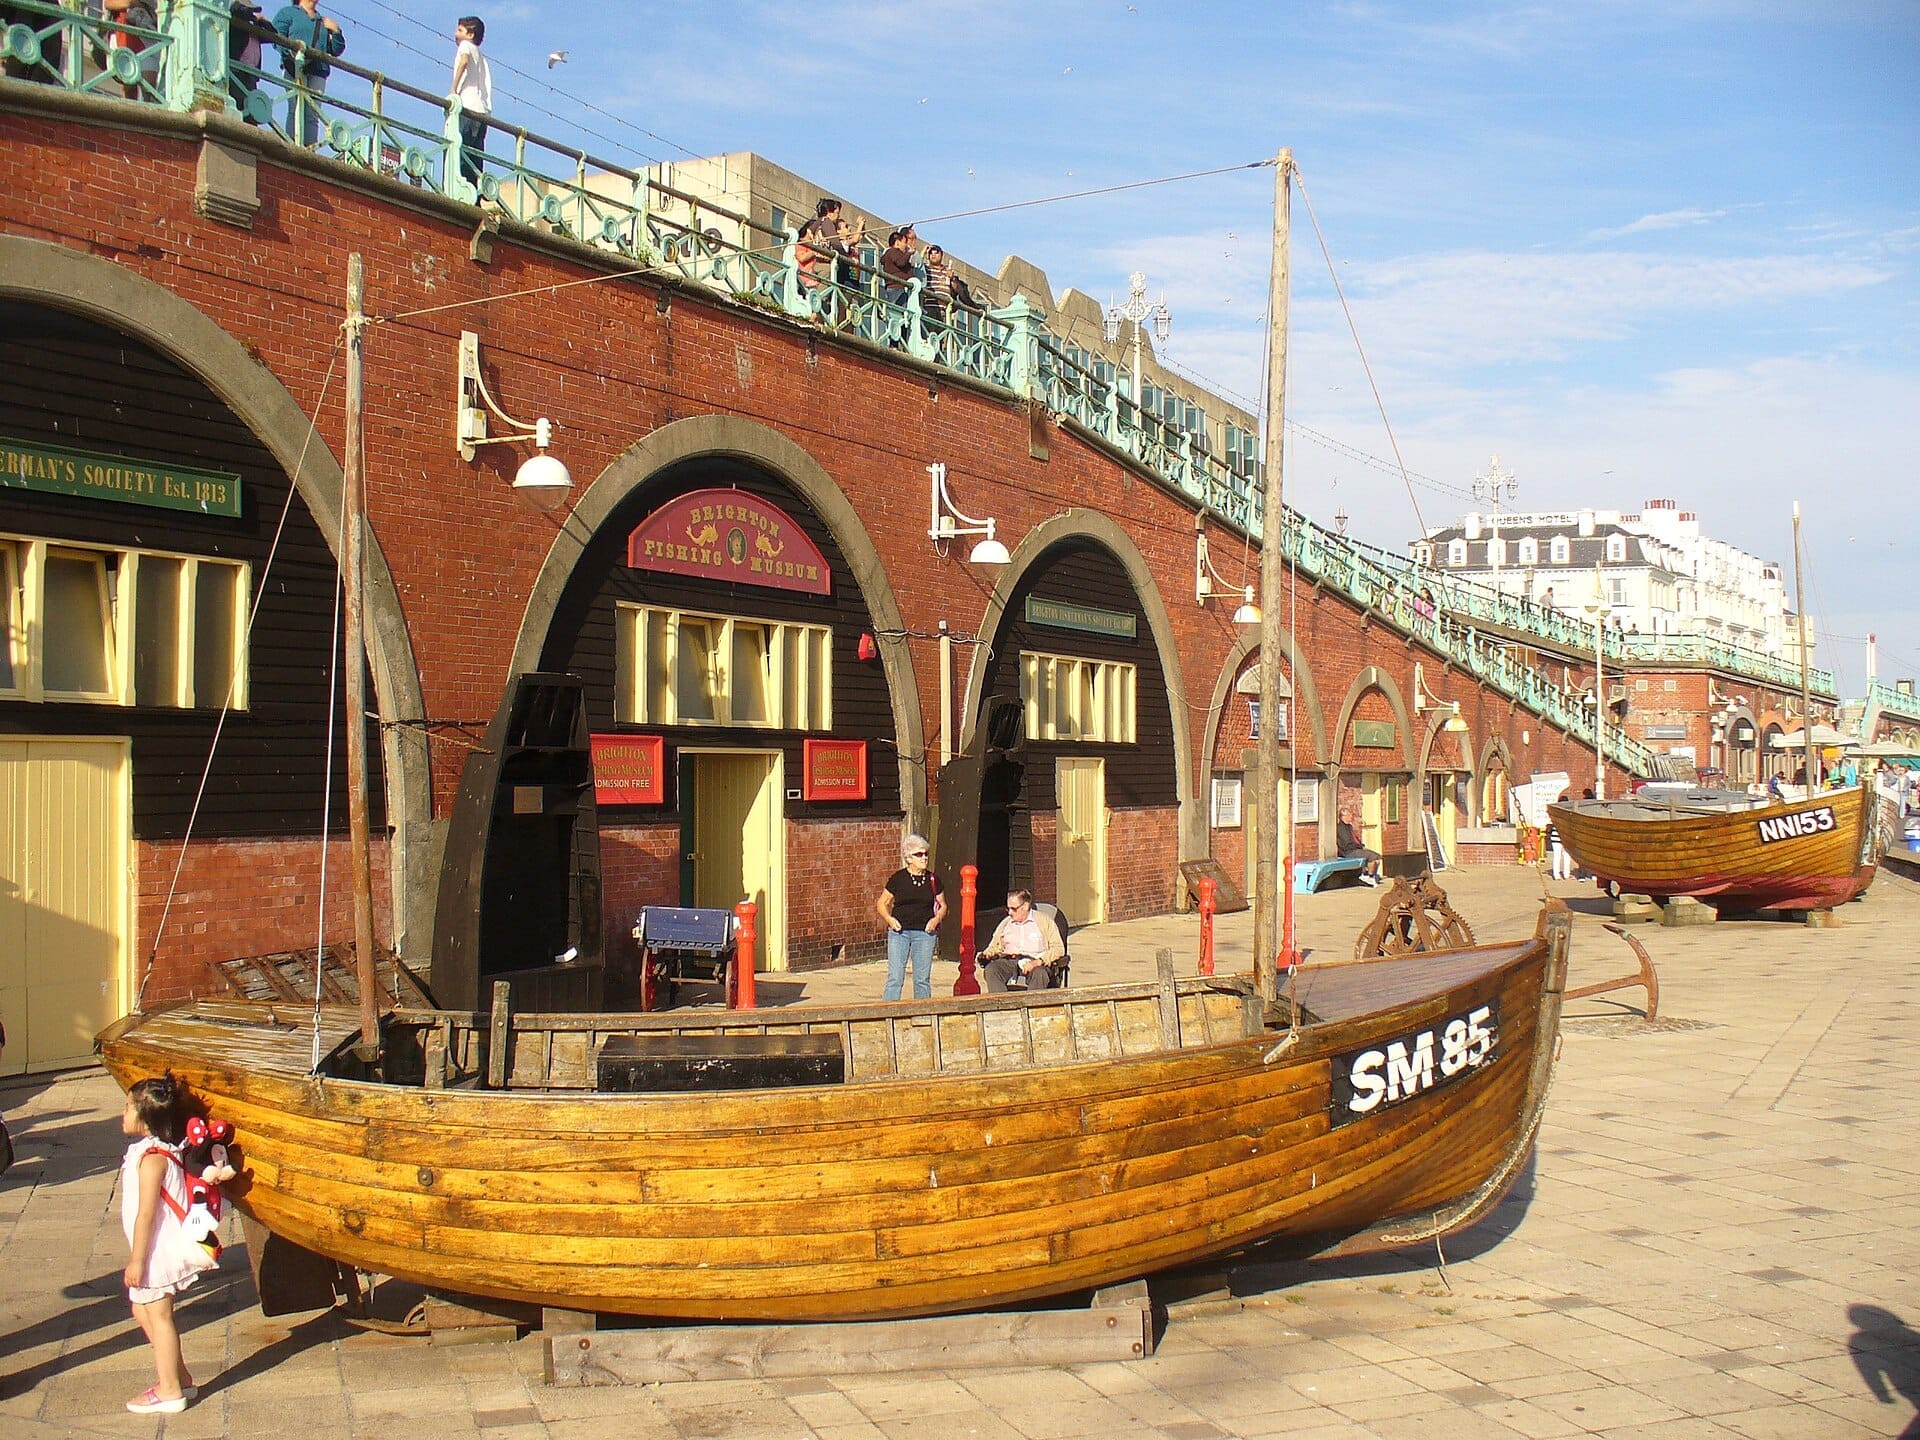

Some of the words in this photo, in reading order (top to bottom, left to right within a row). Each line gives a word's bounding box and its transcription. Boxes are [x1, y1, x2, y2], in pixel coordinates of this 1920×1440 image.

[84, 464, 158, 494] SOCIETY
[164, 476, 190, 499] Est.
[195, 481, 226, 504] 1813
[690, 504, 780, 539] BRIGHTON
[1539, 514, 1573, 524] HOTEL
[644, 539, 723, 566] FISHING
[750, 556, 818, 581] MUSEUM
[596, 746, 646, 761] BRIGHTON
[631, 779, 650, 788] FREE
[841, 778, 856, 786] FREE
